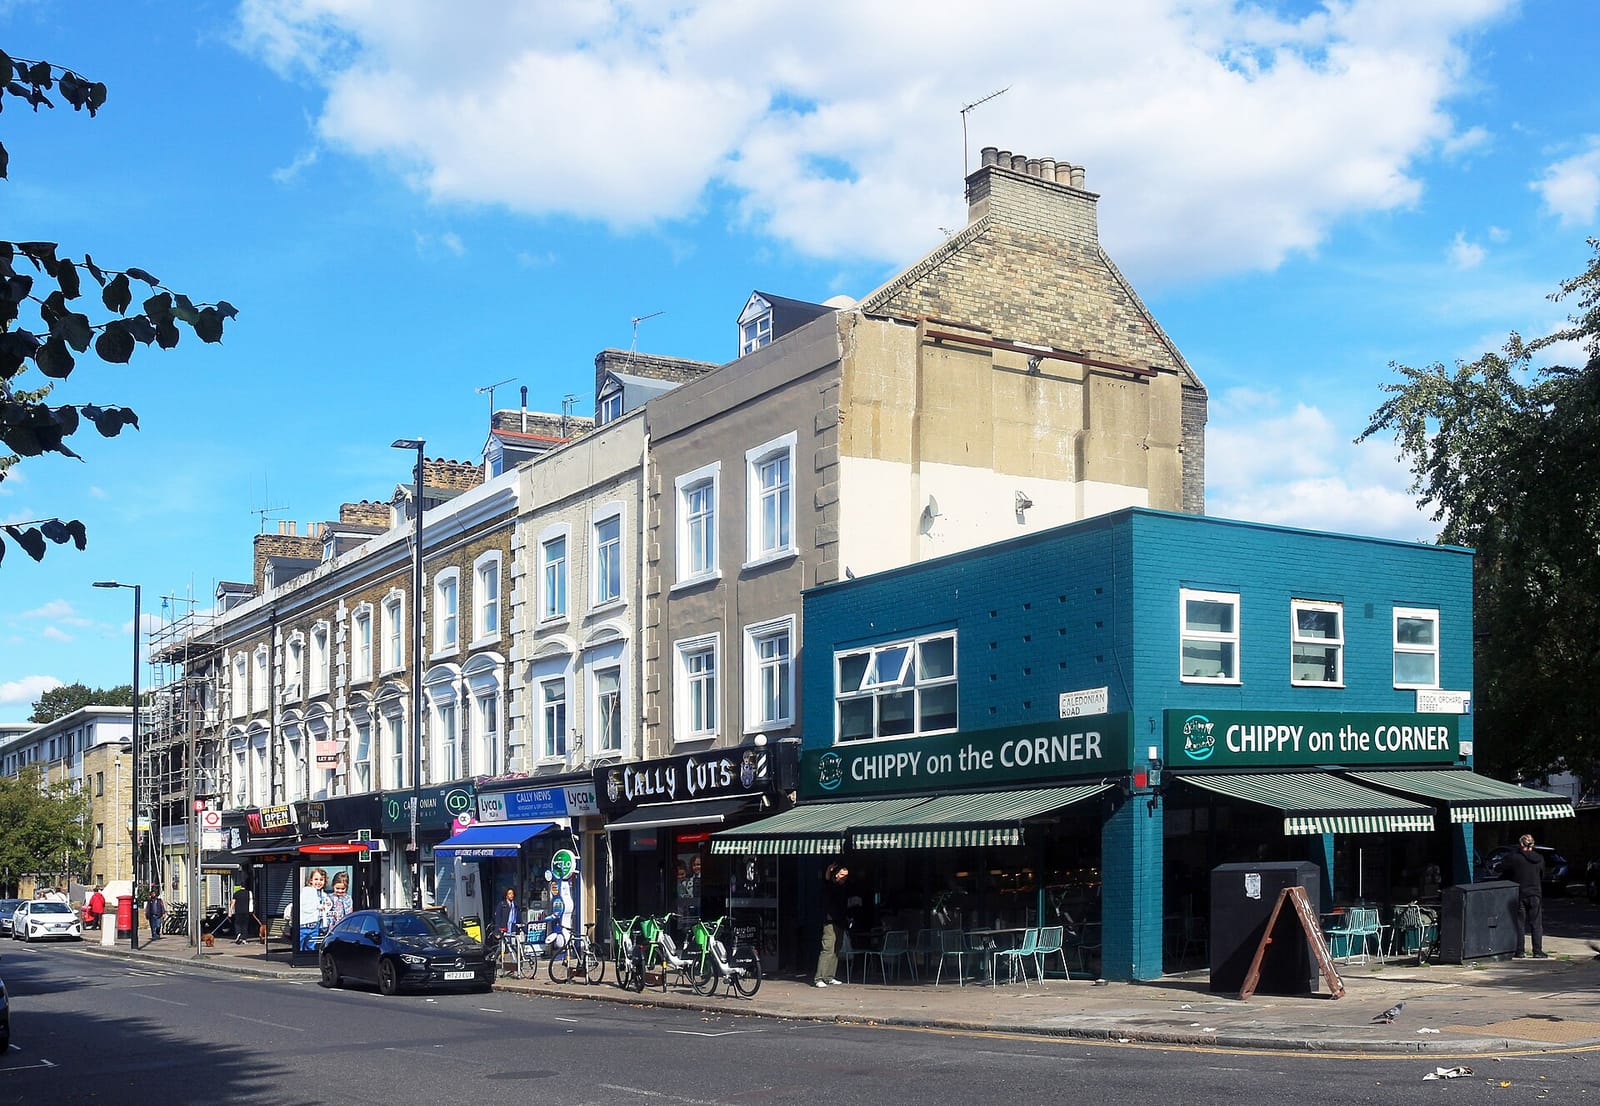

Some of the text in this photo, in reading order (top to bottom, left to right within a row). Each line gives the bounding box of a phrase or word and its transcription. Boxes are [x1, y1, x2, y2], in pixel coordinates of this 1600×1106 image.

[1061, 693, 1105, 707] CALEDONIAN
[1061, 707, 1081, 717] ROAD
[1226, 724, 1304, 752] CHIPPY
[1308, 731, 1333, 751] on
[1338, 724, 1370, 751] the
[1374, 725, 1449, 751] CORNER
[851, 751, 922, 781] CHIPPY
[926, 754, 952, 775] on
[958, 743, 993, 771] the
[1000, 731, 1103, 768] CORNER
[516, 790, 552, 803] CALLY NEWS
[566, 790, 590, 807] Lyca
[403, 798, 437, 810] CAONIAN
[481, 798, 498, 812] Lyca
[264, 811, 288, 822] OPEN
[528, 922, 547, 930] FREE
